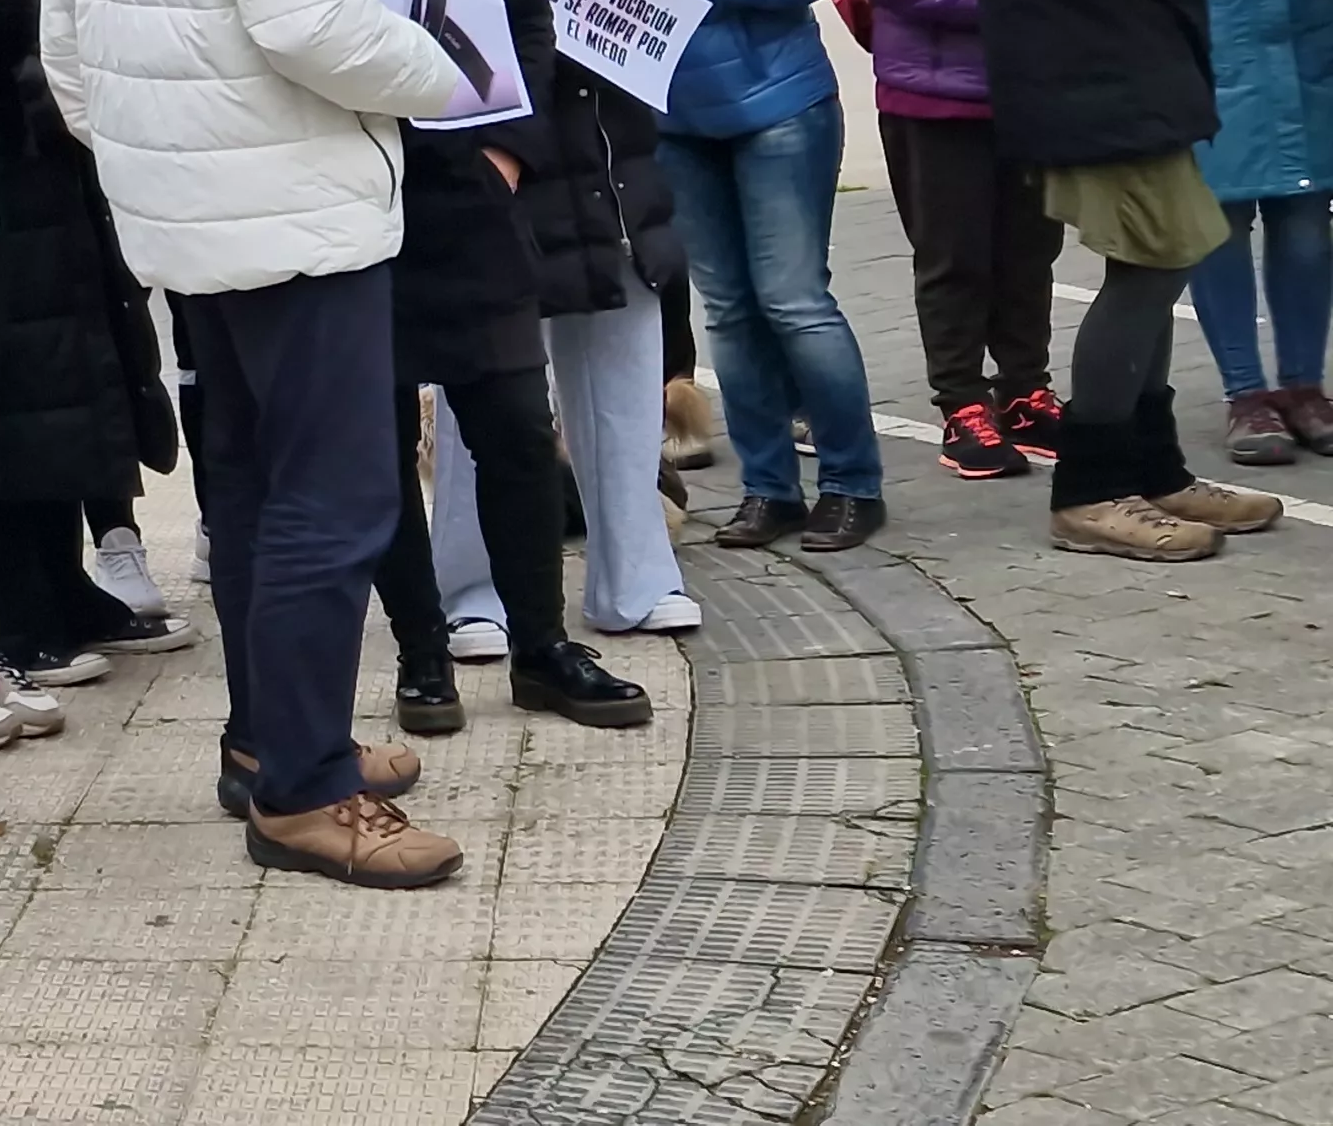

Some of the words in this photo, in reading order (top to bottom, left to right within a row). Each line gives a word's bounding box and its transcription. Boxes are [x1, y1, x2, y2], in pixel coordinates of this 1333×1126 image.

[566, 18, 580, 42] EL
[585, 29, 629, 67] MIEDO
[584, 1, 638, 45] ROMPA
[636, 31, 668, 63] POR
